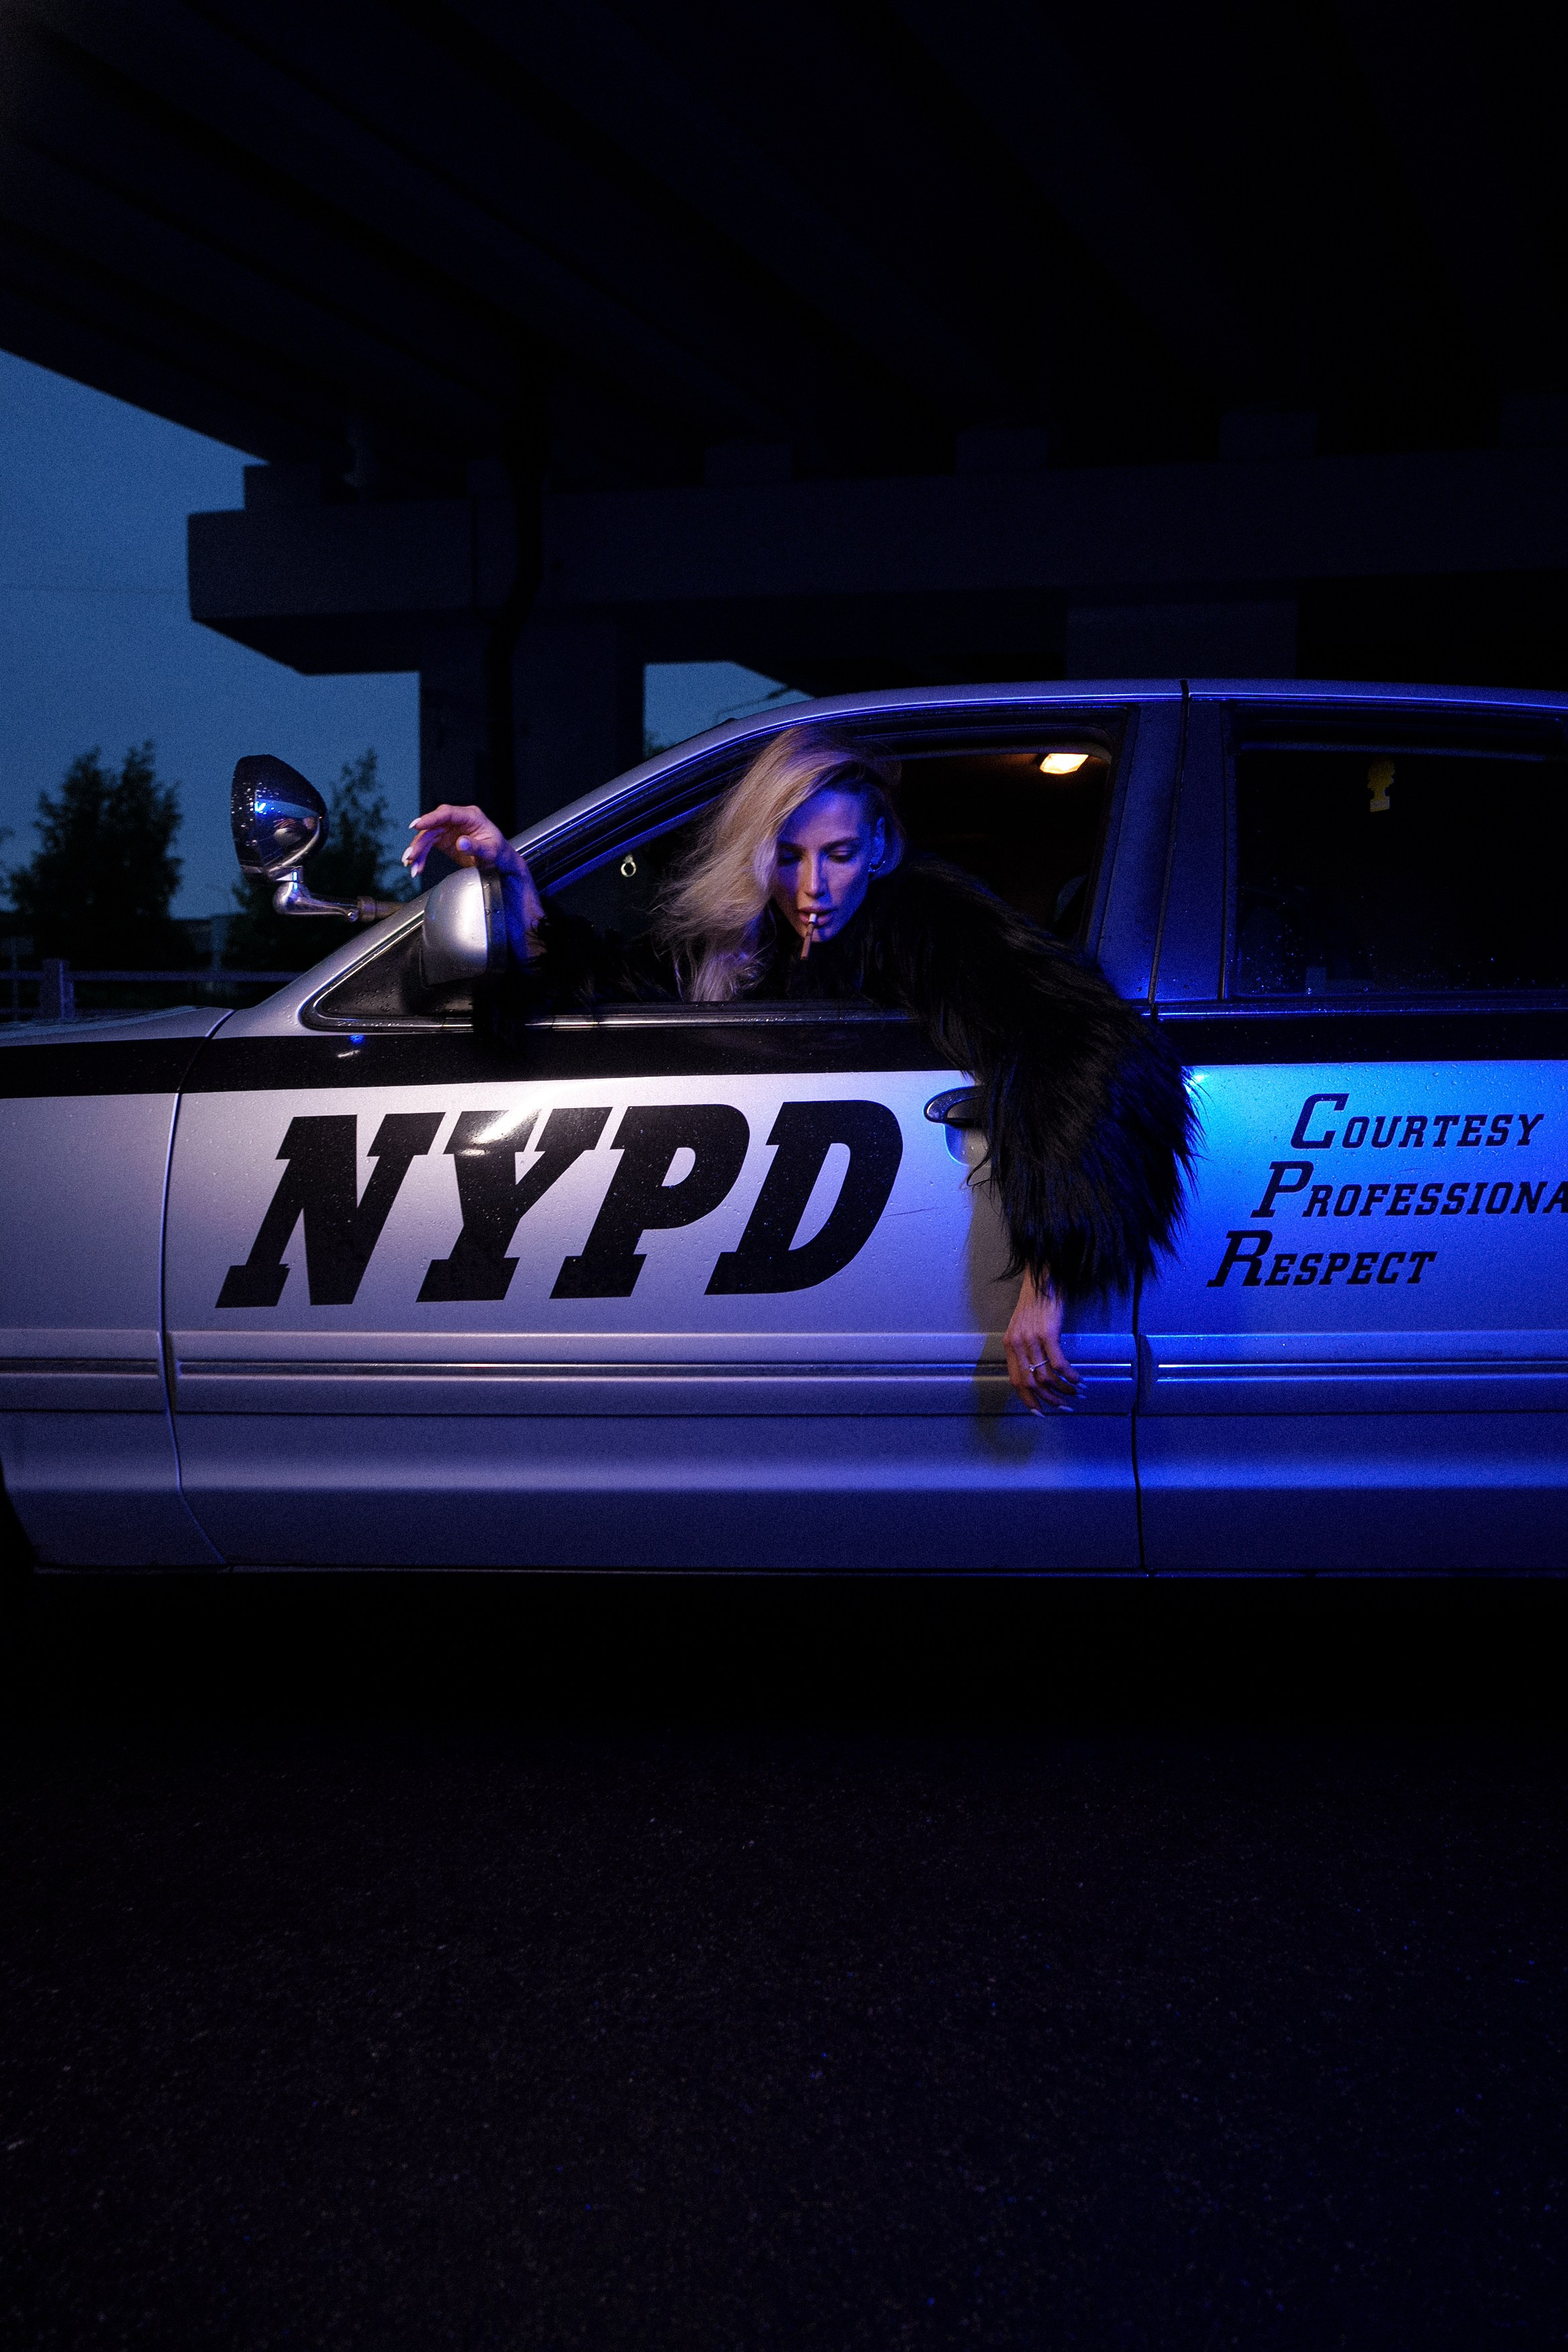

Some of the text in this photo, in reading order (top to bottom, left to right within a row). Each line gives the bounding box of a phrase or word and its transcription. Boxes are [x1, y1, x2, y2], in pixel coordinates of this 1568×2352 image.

[1291, 1093, 1544, 1149] COURTESY
[215, 1099, 903, 1308] NYPD
[1206, 1230, 1437, 1287] RESPECT
